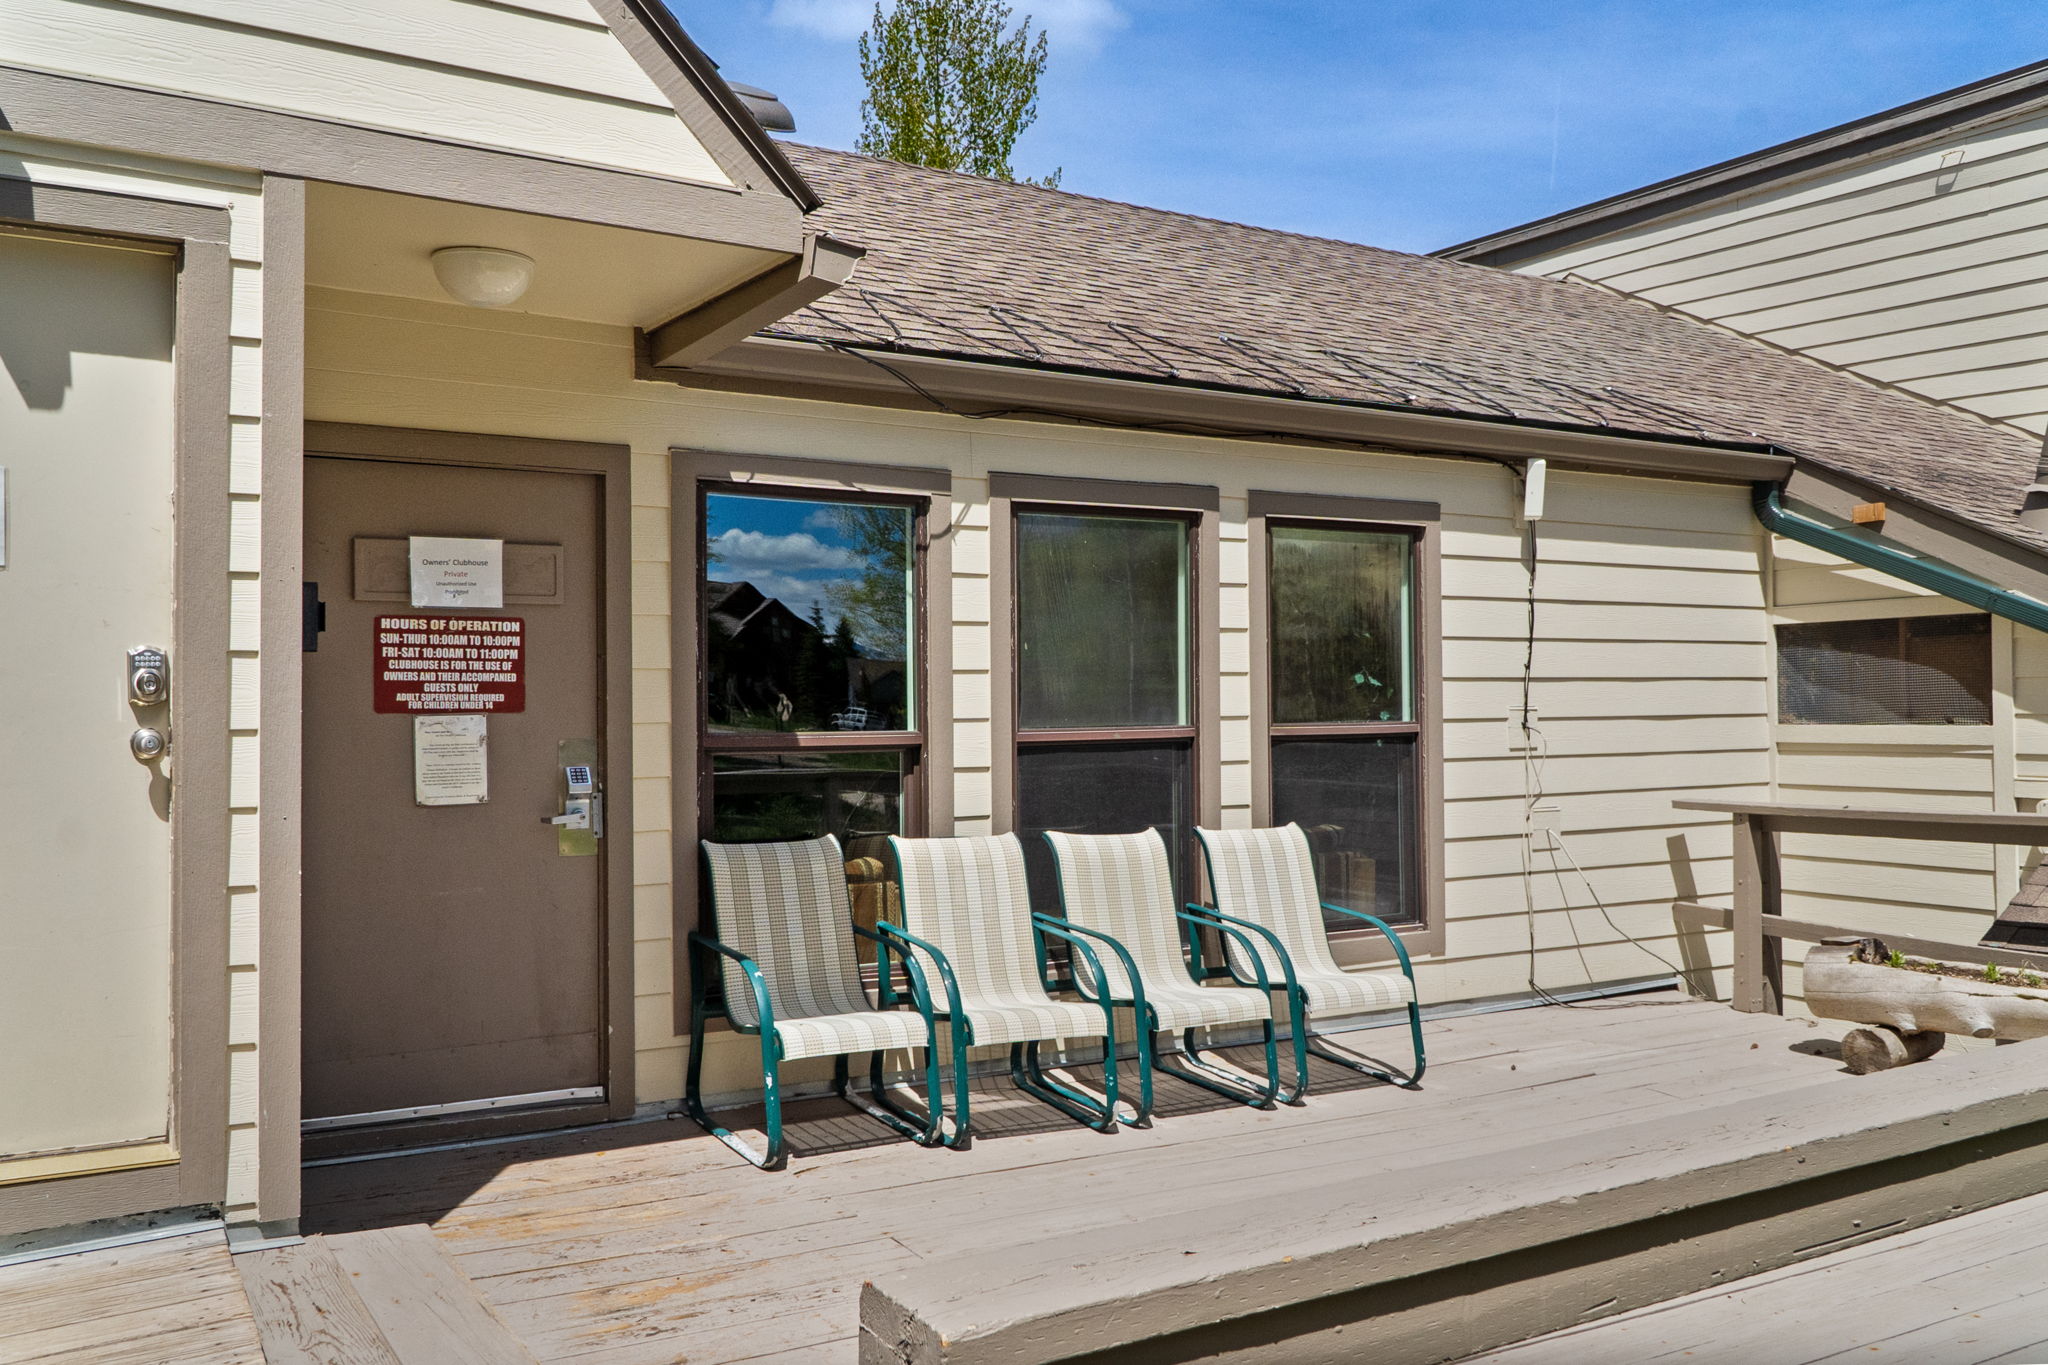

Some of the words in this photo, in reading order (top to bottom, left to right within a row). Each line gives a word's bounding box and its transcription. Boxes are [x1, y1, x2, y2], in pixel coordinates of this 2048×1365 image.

[381, 618, 428, 630] HOURS
[430, 620, 447, 630] OF
[449, 620, 520, 632] OPERATION
[380, 633, 427, 645] SUN-THUR
[429, 634, 468, 646] 10:00AM
[469, 635, 481, 645] TO
[483, 635, 520, 647] 10:00PM
[382, 647, 421, 658] FRI-SAT
[422, 648, 464, 659] 10:00AM
[465, 649, 478, 659] TO
[480, 649, 518, 660] 11:00PM
[388, 660, 439, 670] CLUBHOUSE
[441, 661, 450, 670] IS
[451, 661, 467, 670] FOR
[468, 661, 484, 670] THE
[485, 661, 501, 670] USE
[502, 661, 513, 671] OF
[384, 672, 418, 681] OWNERS
[420, 672, 436, 681] AND
[437, 672, 460, 682] THEIR
[461, 673, 517, 682] ACCOMPANIED
[424, 683, 456, 692] GUESTS
[458, 683, 479, 693] ONLY
[396, 693, 420, 701] ADULT
[421, 693, 469, 702] SUPERVISION
[470, 694, 505, 703] REQUIRED
[408, 701, 422, 709] FOR
[424, 701, 459, 709] CHILDREN
[460, 701, 484, 709] UNDER
[485, 701, 493, 709] 14
